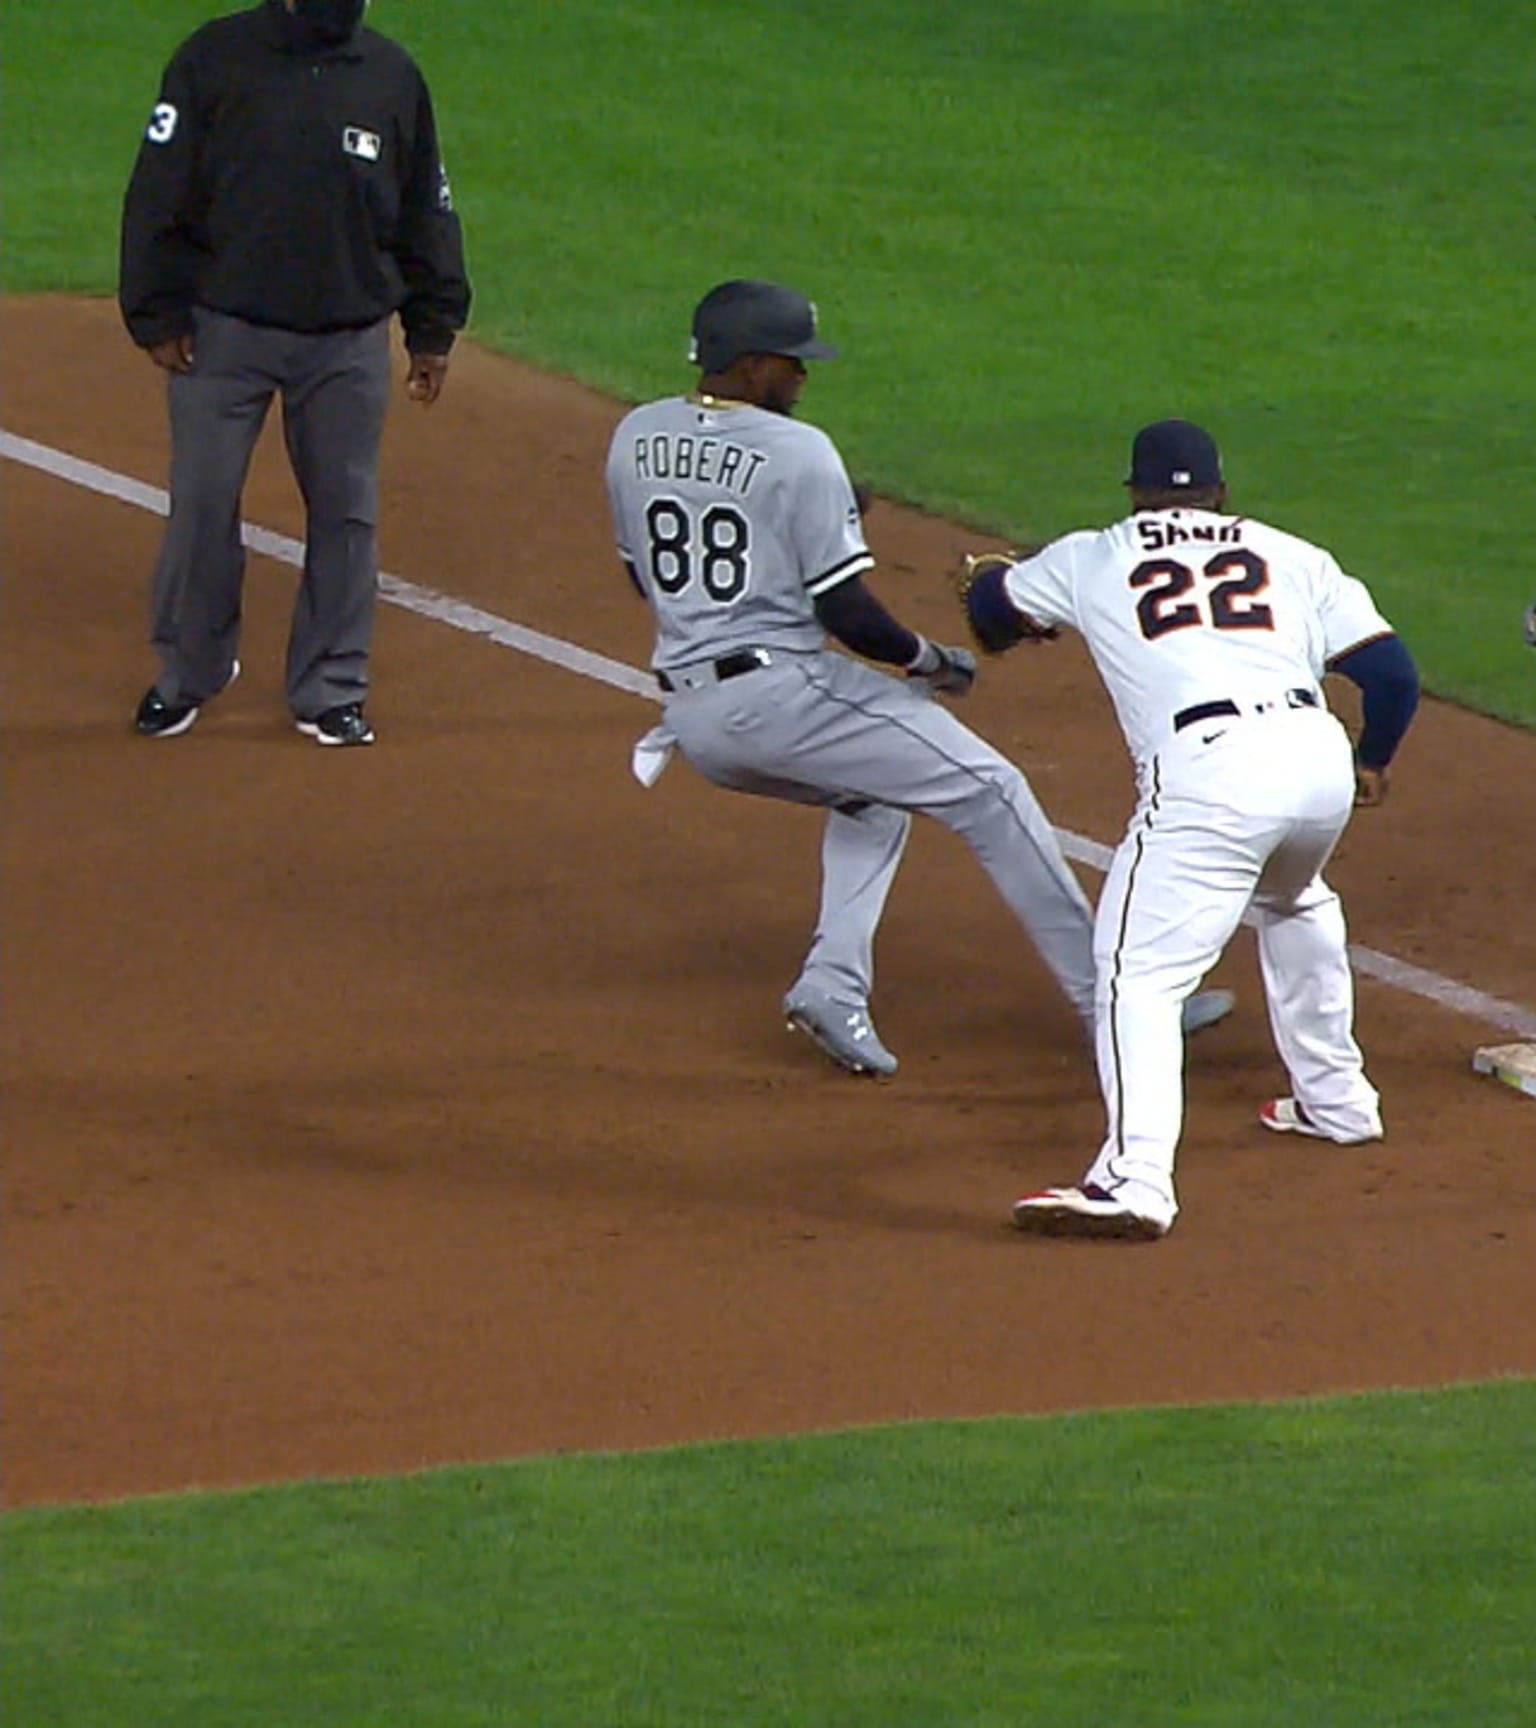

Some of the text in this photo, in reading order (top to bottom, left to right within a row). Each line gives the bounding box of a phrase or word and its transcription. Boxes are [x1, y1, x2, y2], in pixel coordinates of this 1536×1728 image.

[147, 102, 179, 143] 3
[634, 434, 768, 495] ROBERT
[644, 496, 751, 605] 88
[1128, 547, 1275, 642] 22
